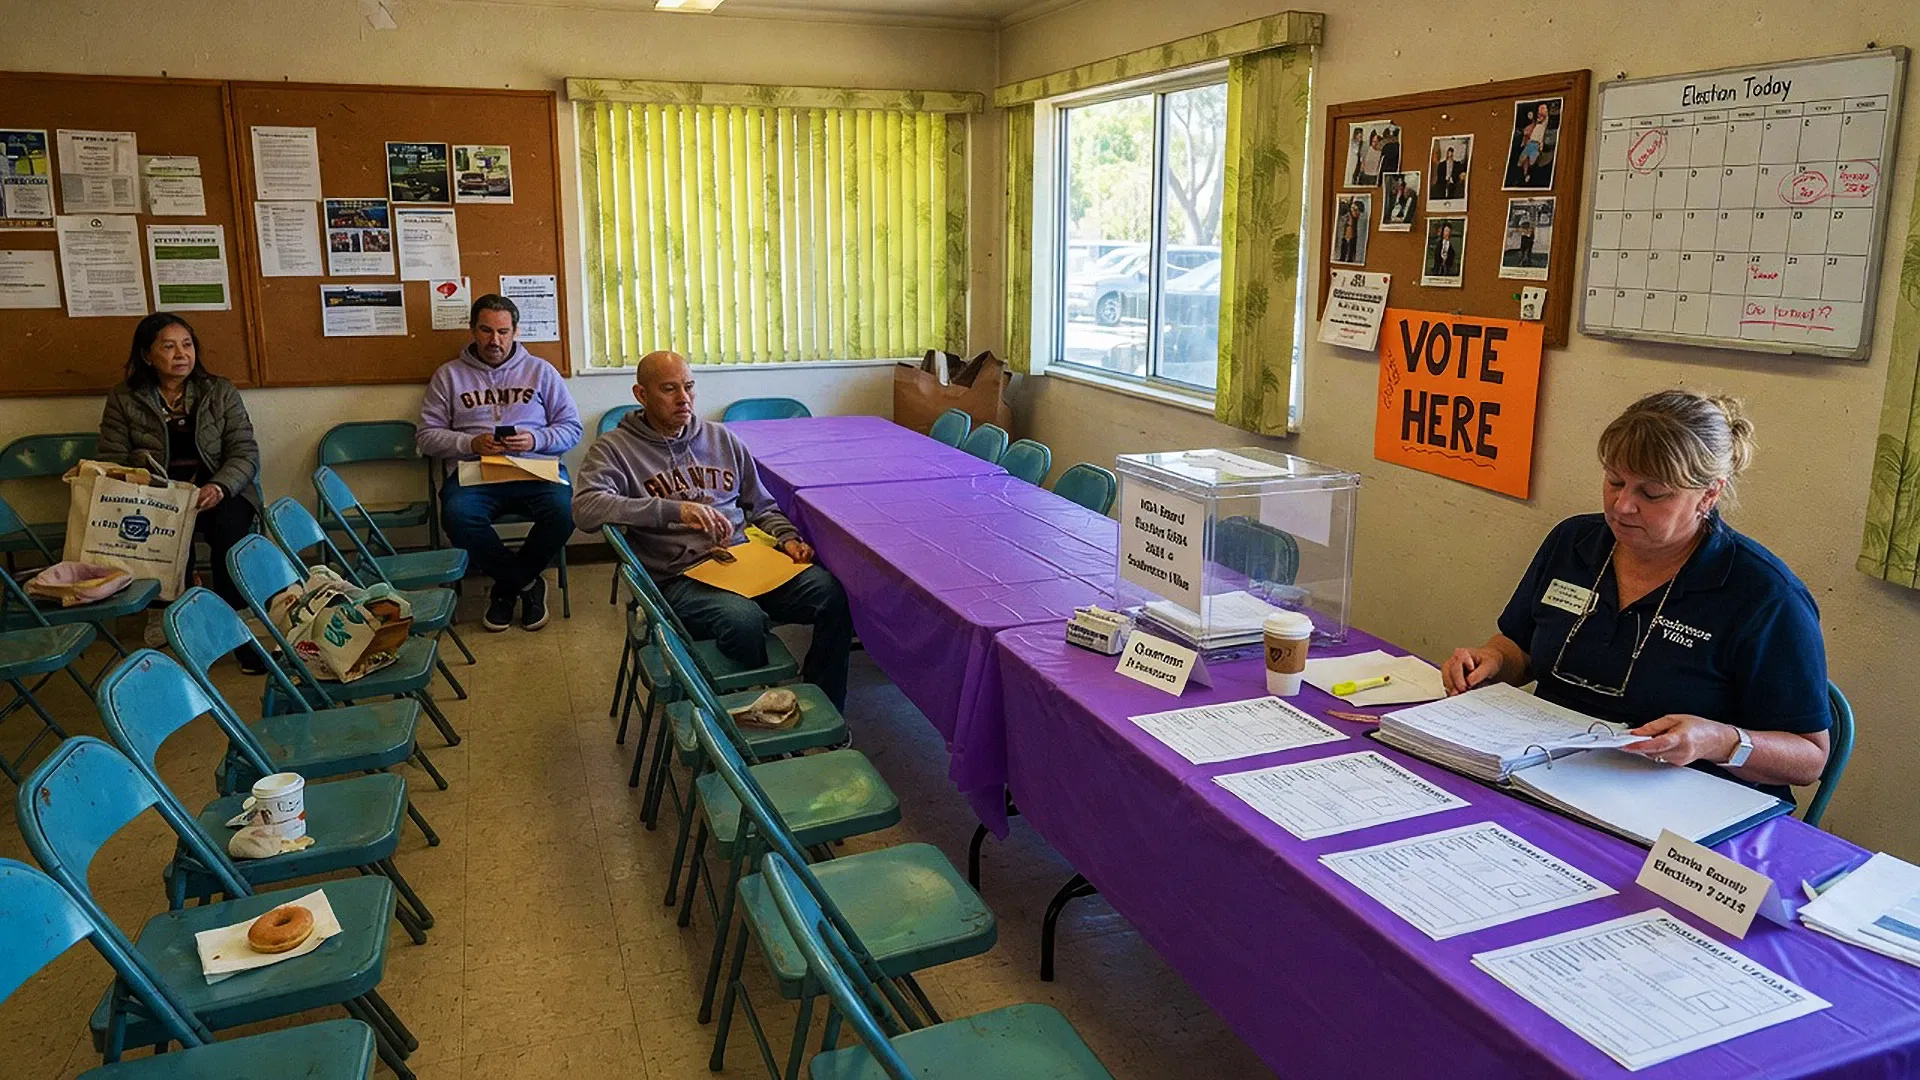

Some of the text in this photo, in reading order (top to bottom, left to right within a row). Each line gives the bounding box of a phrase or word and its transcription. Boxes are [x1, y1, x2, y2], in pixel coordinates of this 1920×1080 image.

[1743, 75, 1792, 102] Today
[1400, 319, 1508, 384] VOTE
[460, 387, 535, 409] GIANTS
[1401, 389, 1500, 460] HERE
[643, 466, 735, 499] GIANTS
